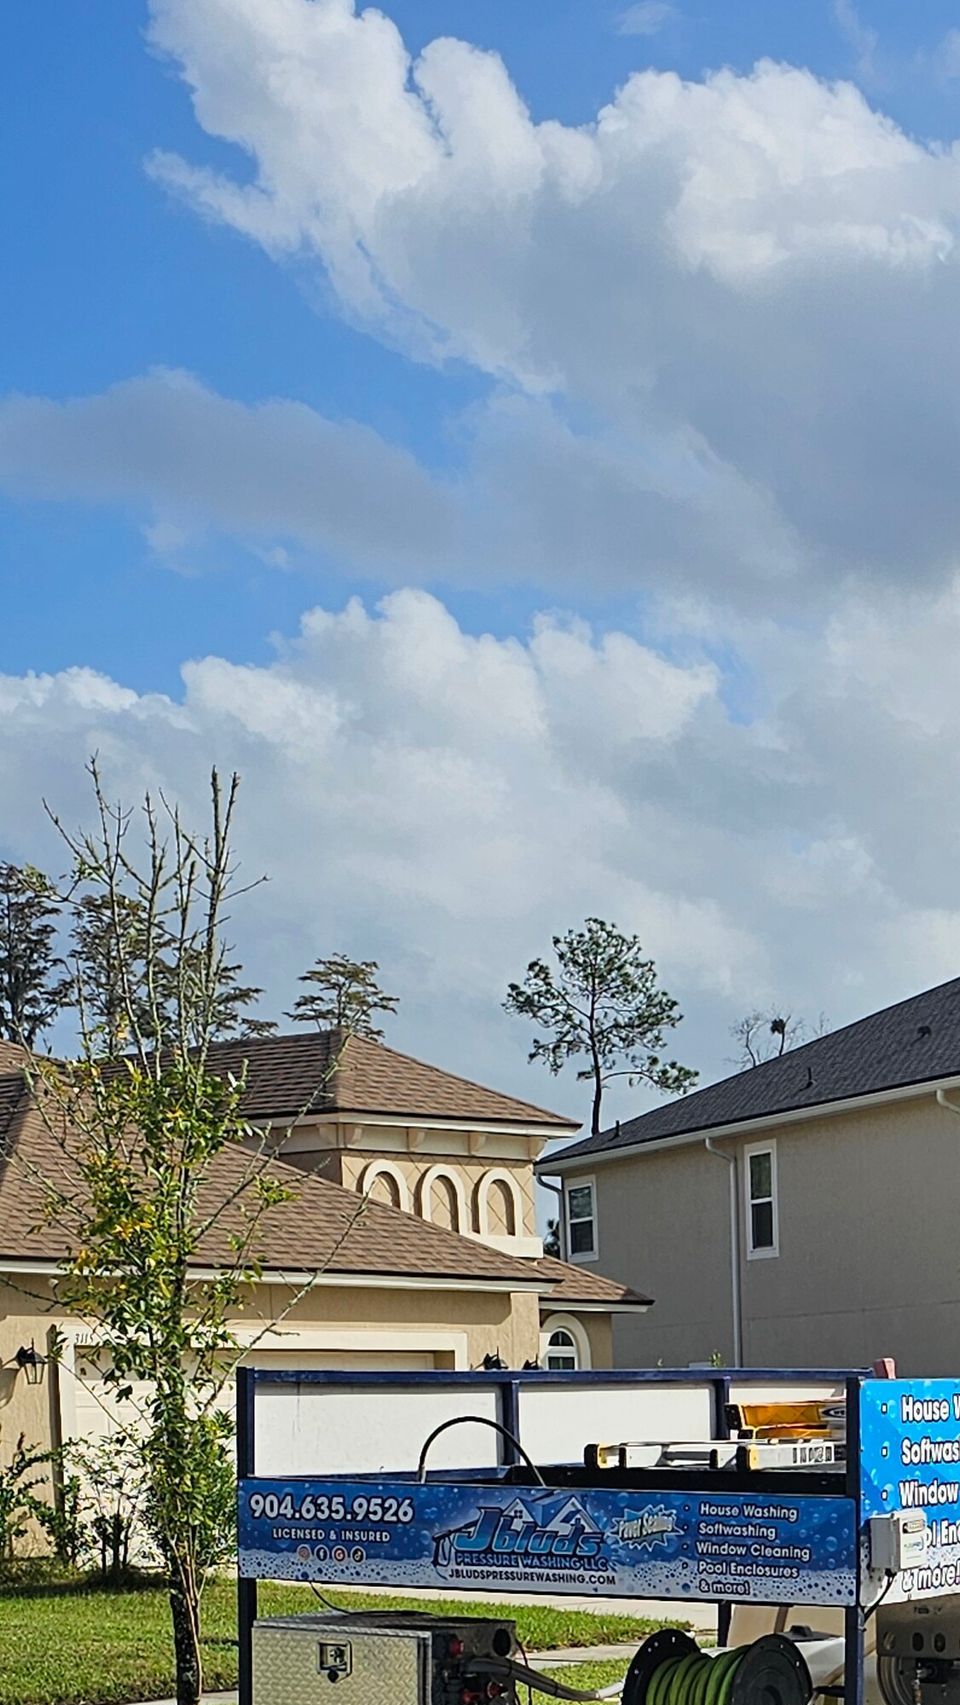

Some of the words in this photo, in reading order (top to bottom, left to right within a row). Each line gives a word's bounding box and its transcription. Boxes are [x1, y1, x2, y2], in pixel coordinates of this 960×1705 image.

[901, 1395, 950, 1422] House
[899, 1479, 960, 1507] Window
[250, 1494, 414, 1523] 904.635.9526
[700, 1503, 739, 1517] House
[743, 1504, 798, 1522] Washing
[273, 1528, 325, 1540] LICENSED
[329, 1530, 337, 1541] &
[341, 1530, 390, 1542] INSURED
[452, 1506, 605, 1556] Jbluds
[699, 1523, 776, 1540] Softwashing
[696, 1541, 747, 1556] Window
[750, 1544, 810, 1561] Cleaning
[455, 1552, 519, 1568] PRESSURE
[519, 1554, 583, 1570] WASHING
[584, 1557, 609, 1572] LLC
[699, 1560, 727, 1574] Pool
[730, 1562, 798, 1578] Enclosures
[449, 1568, 616, 1585] JBLUDSPRESSUREWASHING.COM
[700, 1580, 709, 1593] &
[713, 1581, 750, 1595] more!
